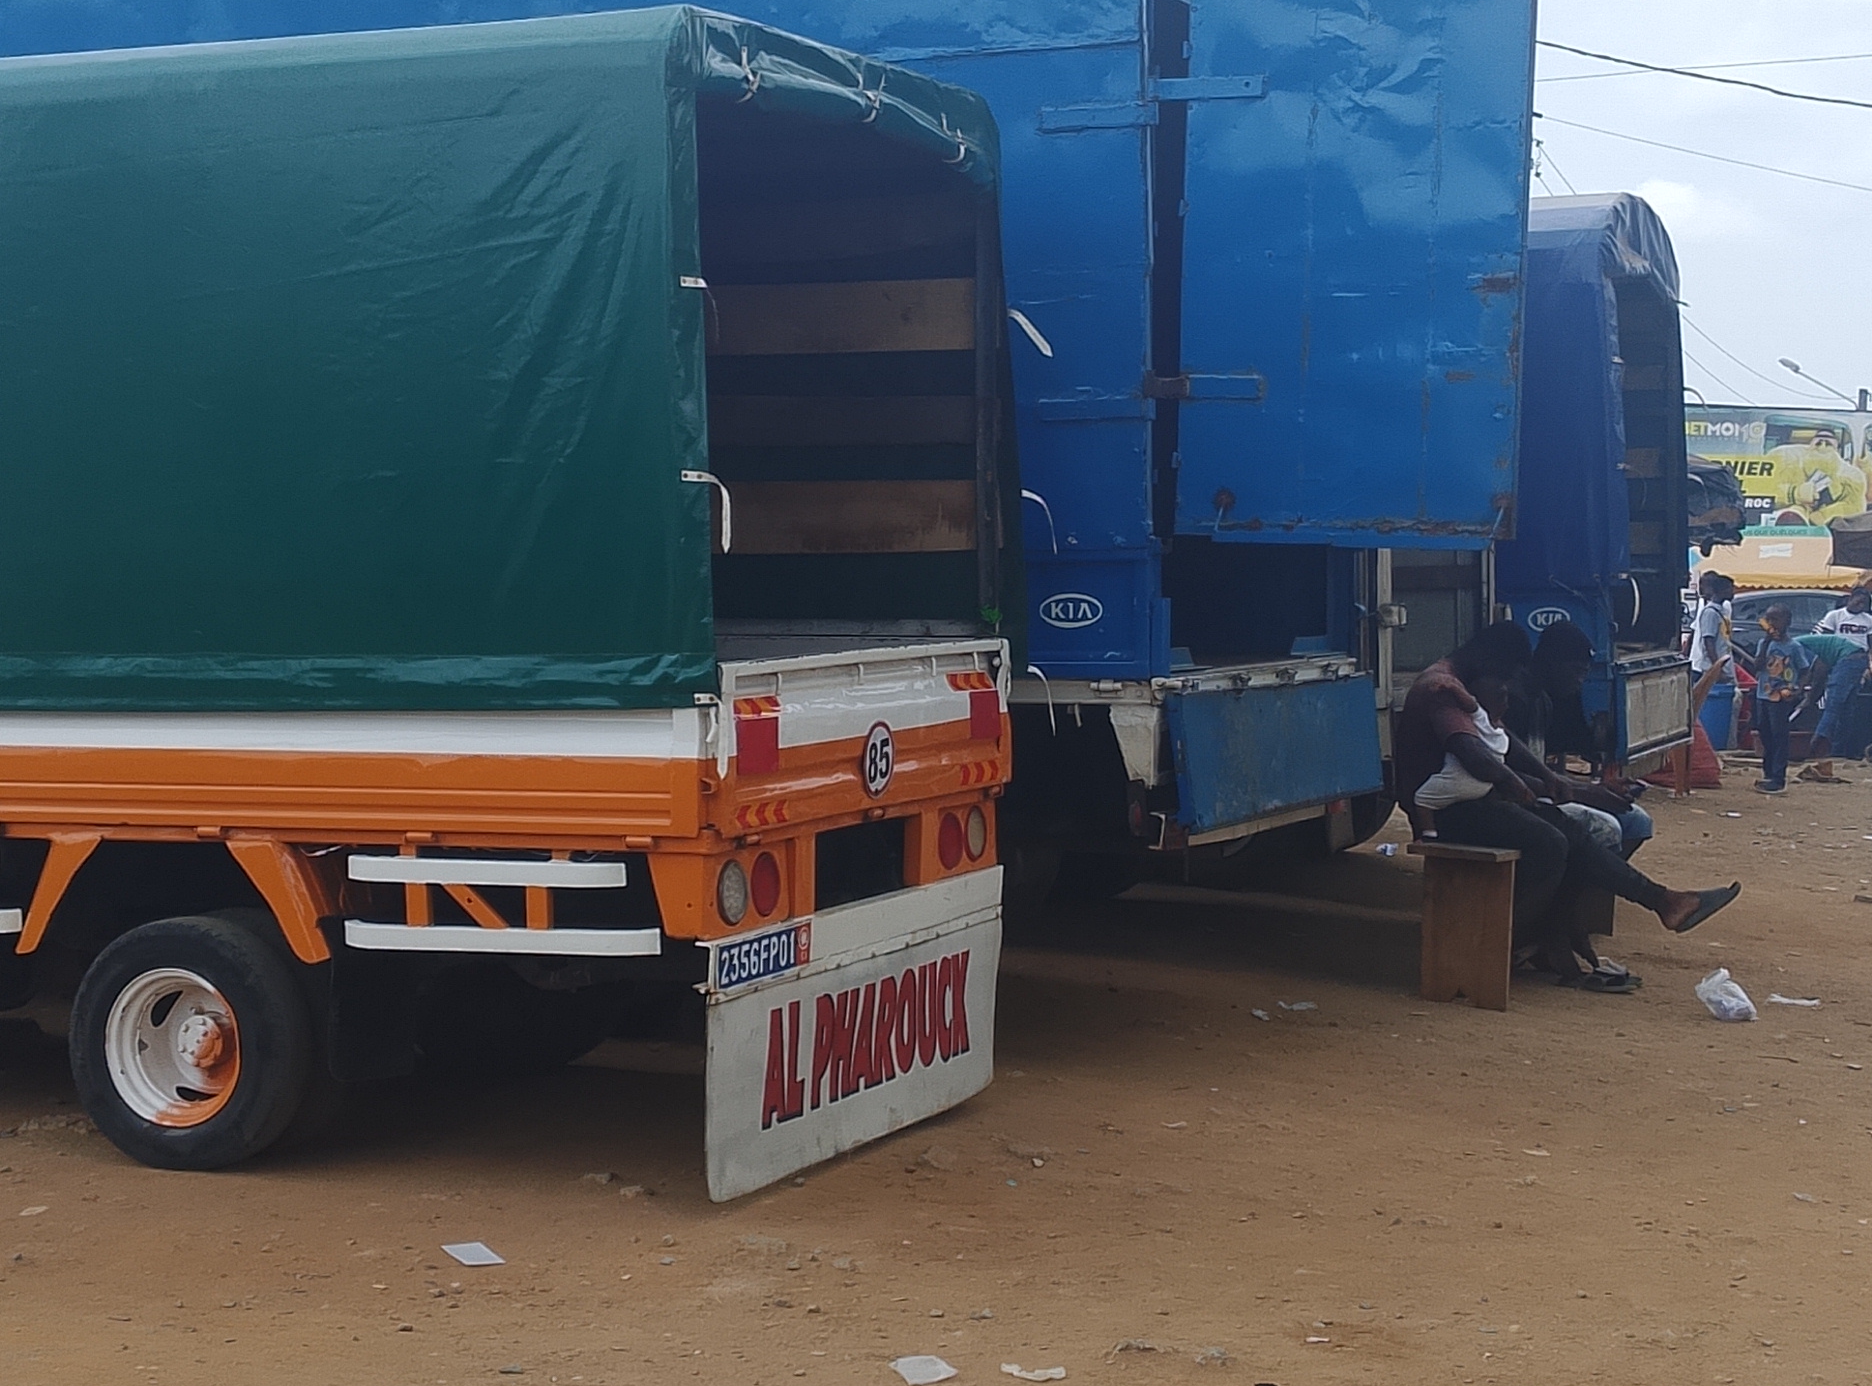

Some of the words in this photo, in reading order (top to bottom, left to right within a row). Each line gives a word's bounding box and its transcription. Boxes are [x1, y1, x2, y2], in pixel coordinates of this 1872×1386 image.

[1711, 460, 1775, 477] NIER
[1744, 498, 1772, 508] ROC
[1050, 602, 1093, 619] KIA
[868, 737, 890, 784] 85
[720, 930, 796, 986] 2356FP01
[761, 1000, 805, 1132] AL
[810, 948, 971, 1111] PHAROUCK
